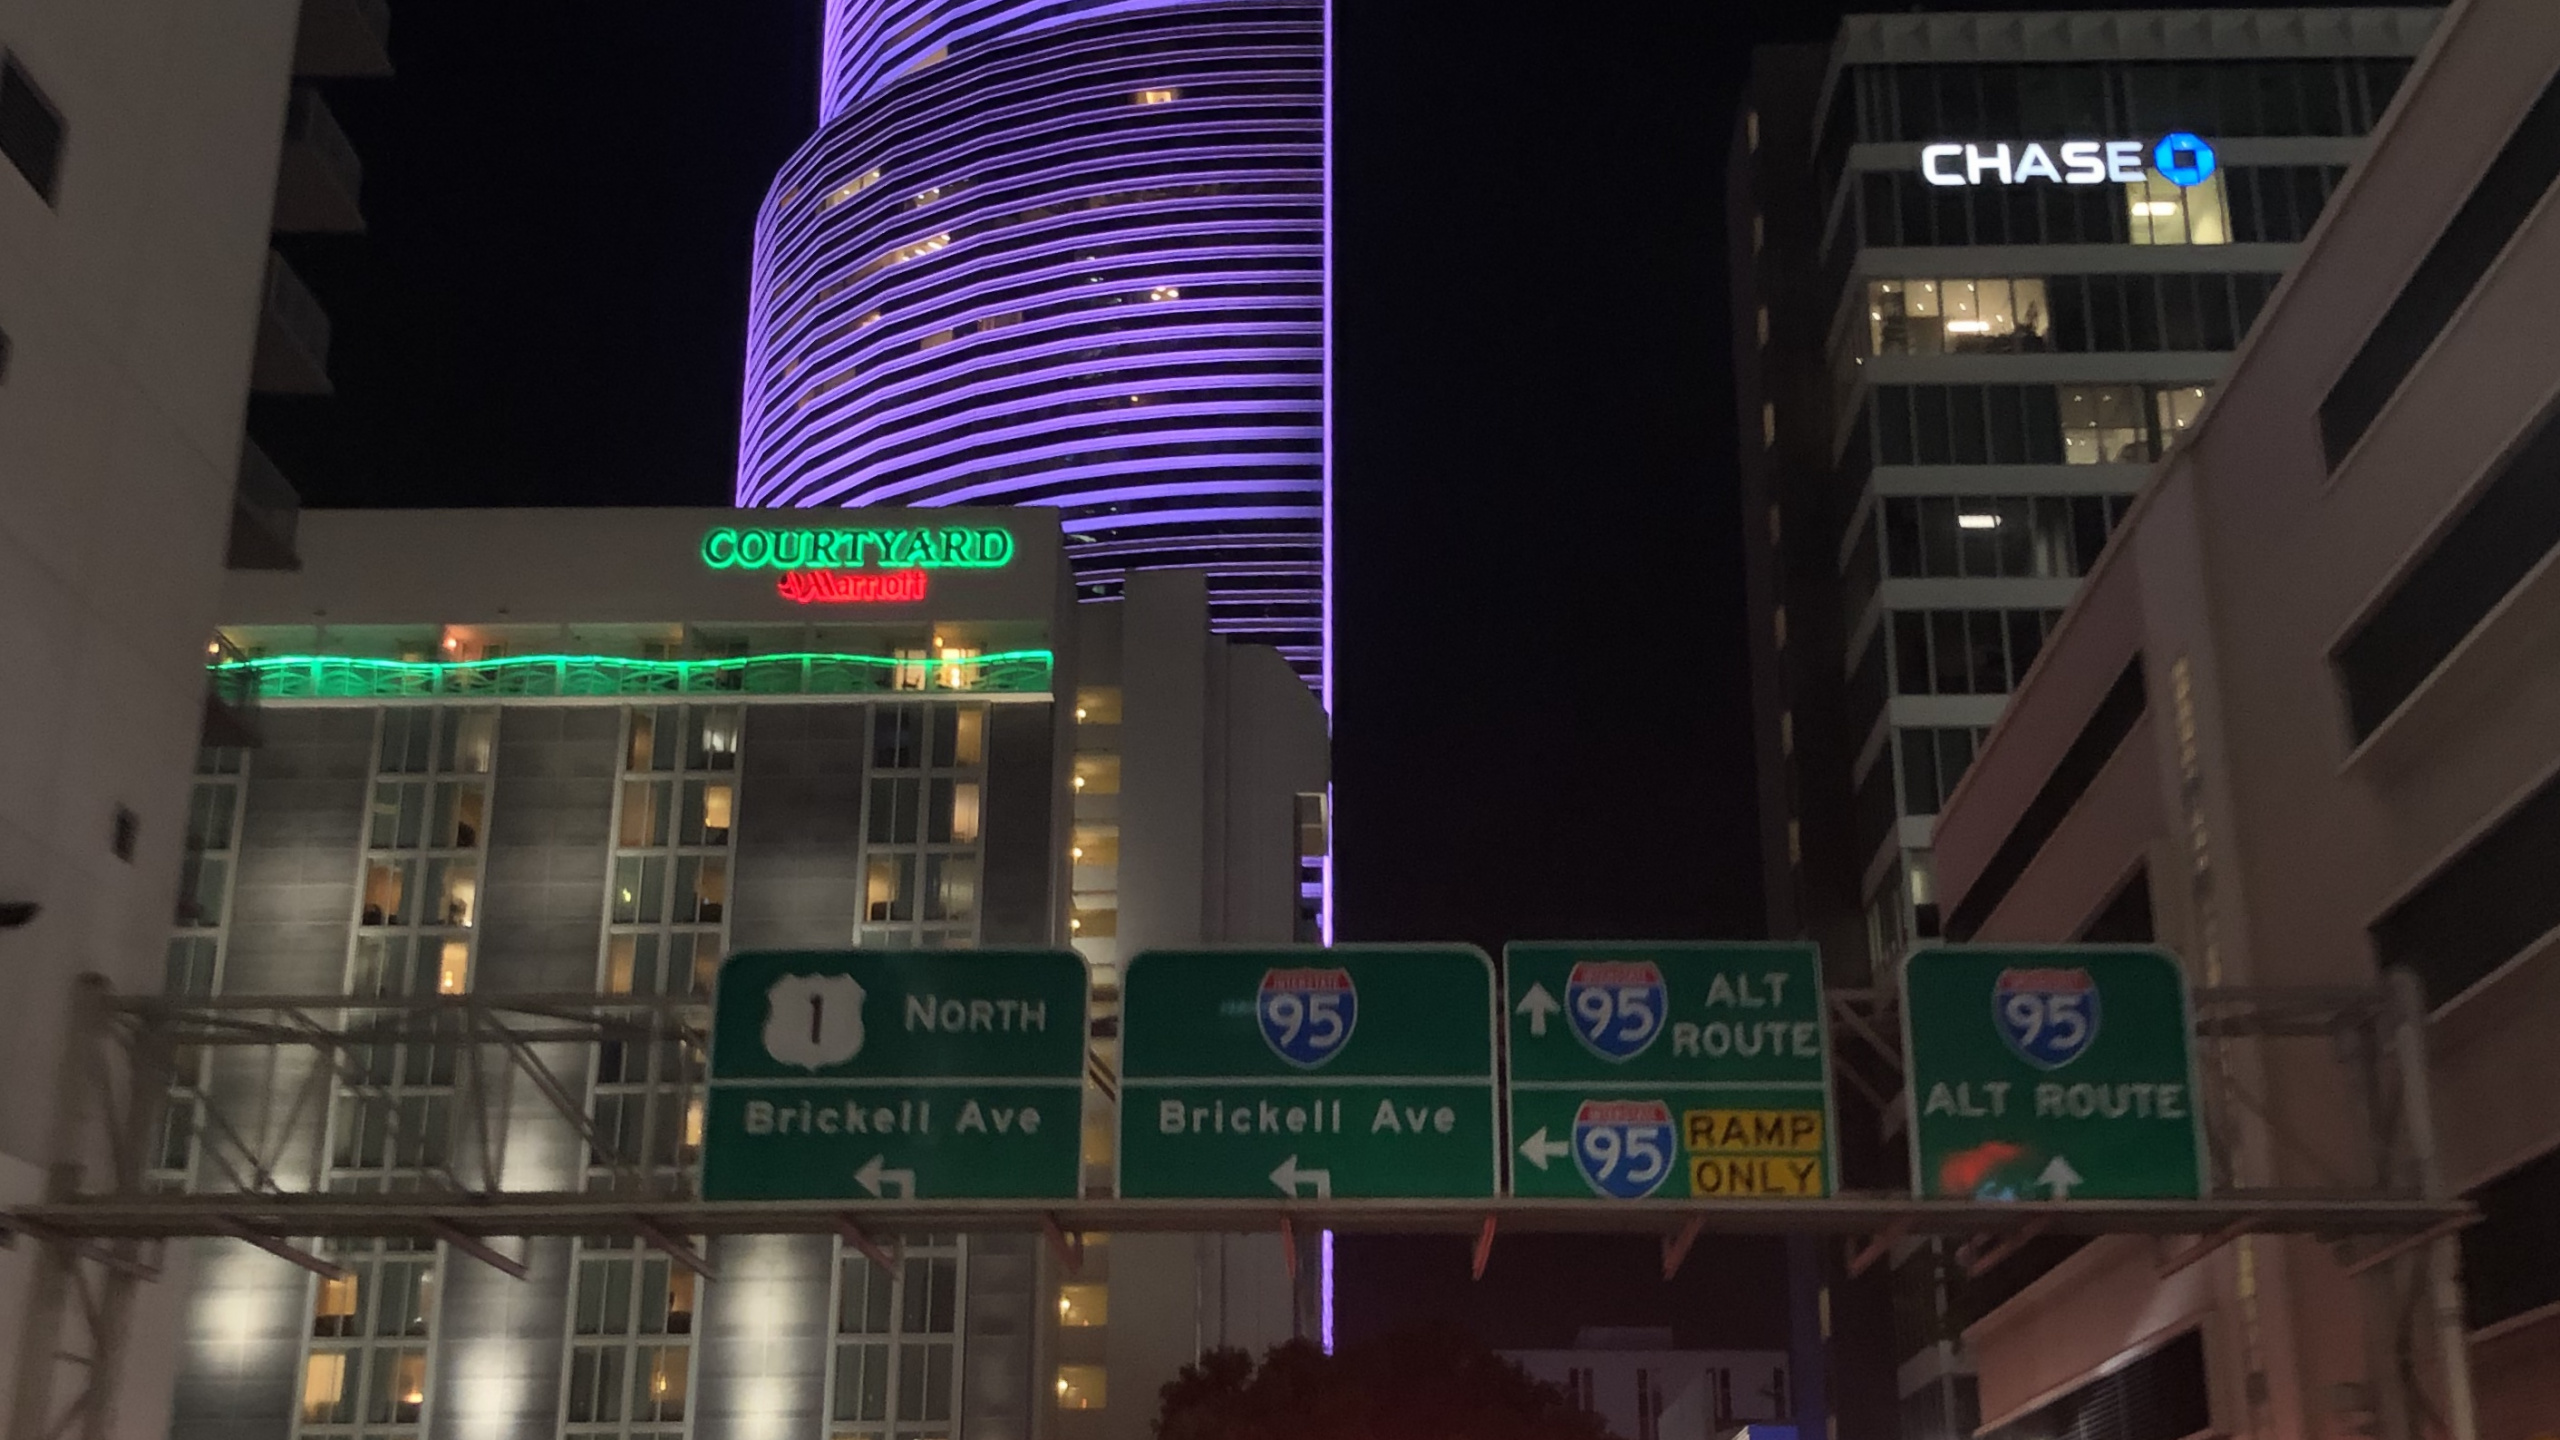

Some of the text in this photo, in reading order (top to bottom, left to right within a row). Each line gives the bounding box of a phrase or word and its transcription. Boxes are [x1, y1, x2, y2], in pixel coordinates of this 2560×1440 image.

[1921, 141, 2148, 186] CHASE
[702, 527, 1014, 568] COURTYARD
[777, 569, 928, 603] Marriott
[1704, 972, 1790, 1008] ALT
[809, 993, 824, 1046] 1
[1268, 992, 1344, 1048] 95
[1576, 986, 1655, 1042] 95
[2004, 993, 2087, 1049] 95
[1672, 1021, 1820, 1057] ROUTE
[744, 1100, 1042, 1135] Brickell Ave
[1159, 1099, 1456, 1134] Brickell Ave
[1923, 1081, 2187, 1119] ALT ROUTE
[1688, 1115, 1818, 1148] RAMP
[1583, 1127, 1662, 1183] 95
[1695, 1160, 1817, 1194] ONLY
